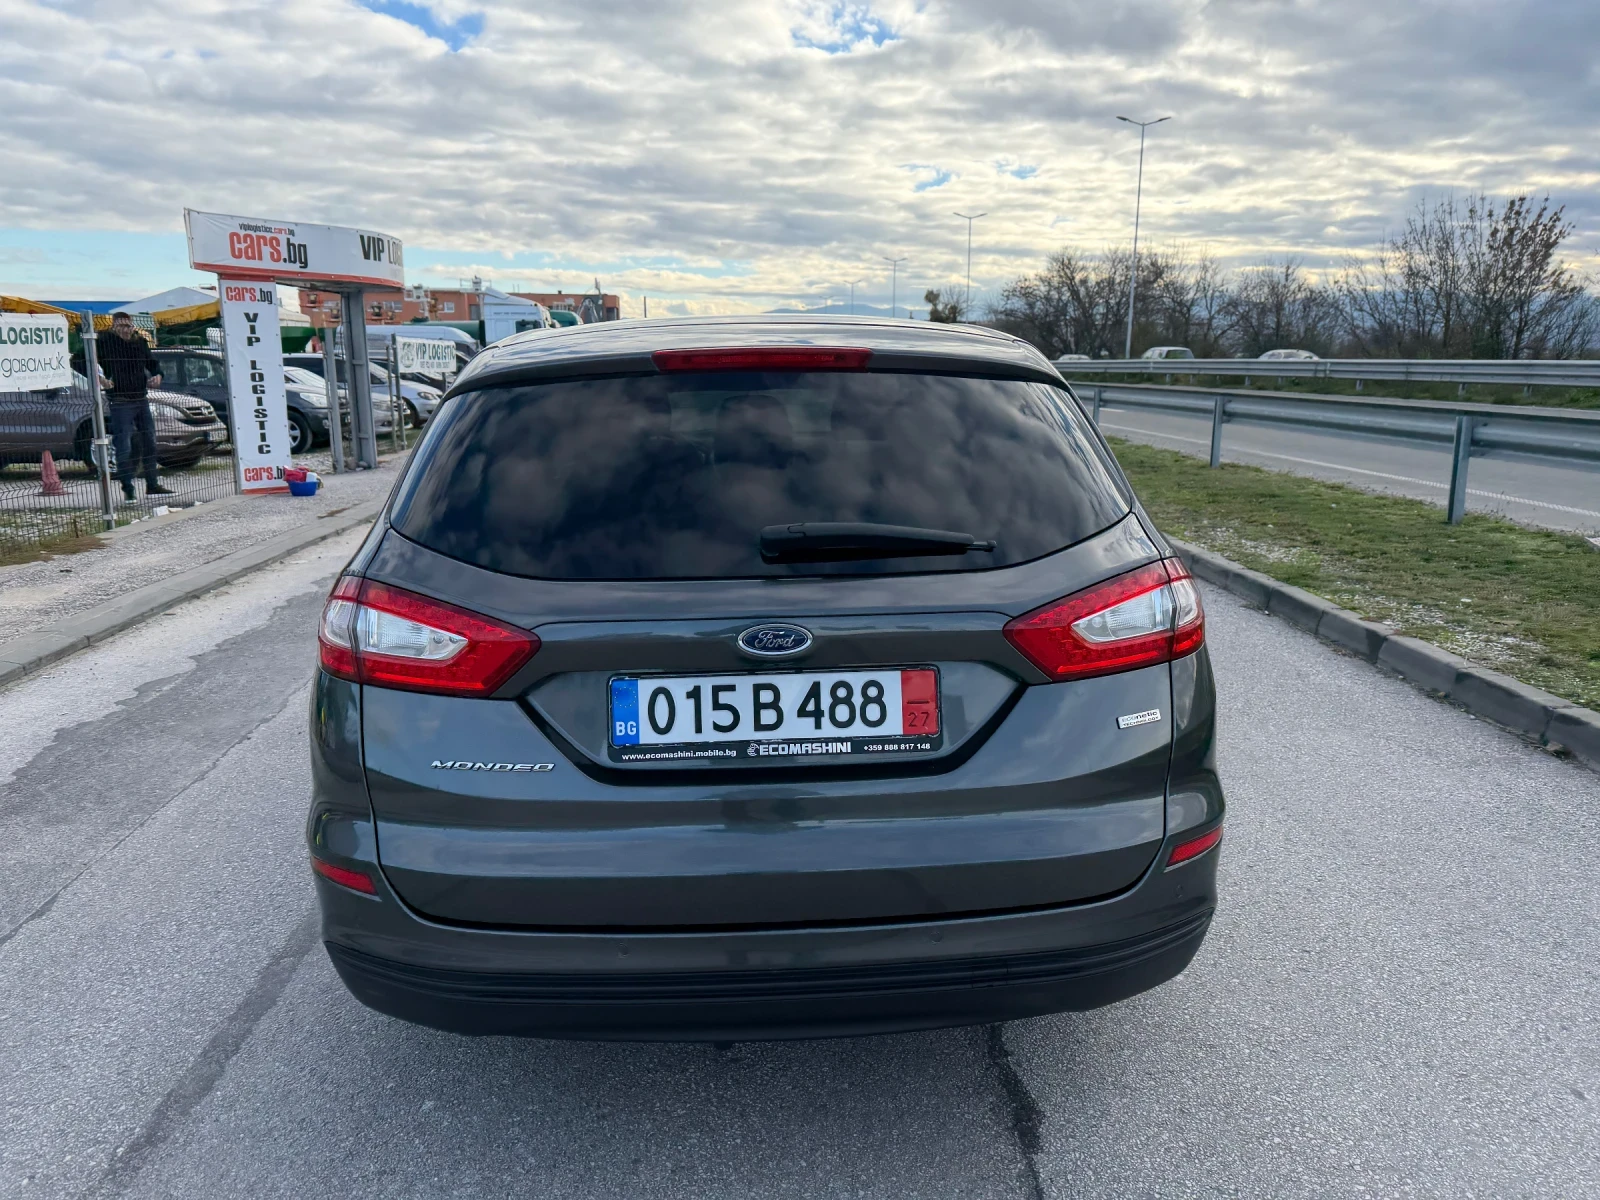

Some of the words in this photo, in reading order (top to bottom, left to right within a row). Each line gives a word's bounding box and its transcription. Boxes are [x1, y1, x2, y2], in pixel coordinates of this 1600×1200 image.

[229, 231, 309, 269] cars.bg
[359, 234, 385, 262] VIP
[225, 286, 273, 304] cars.bg
[0, 326, 64, 345] LOGISTIC
[243, 312, 261, 347] VIP
[416, 342, 427, 360] VIP
[428, 343, 456, 361] LOGISTIC
[250, 360, 272, 455] LOGISTIC
[754, 630, 795, 648] Ford
[615, 721, 637, 736] BG
[907, 711, 930, 728] 27
[621, 748, 737, 761] www.ecomashini.mobile.bg
[759, 741, 852, 756] ECOMASHINI
[863, 744, 882, 752] +359
[430, 760, 555, 772] MONDEO
